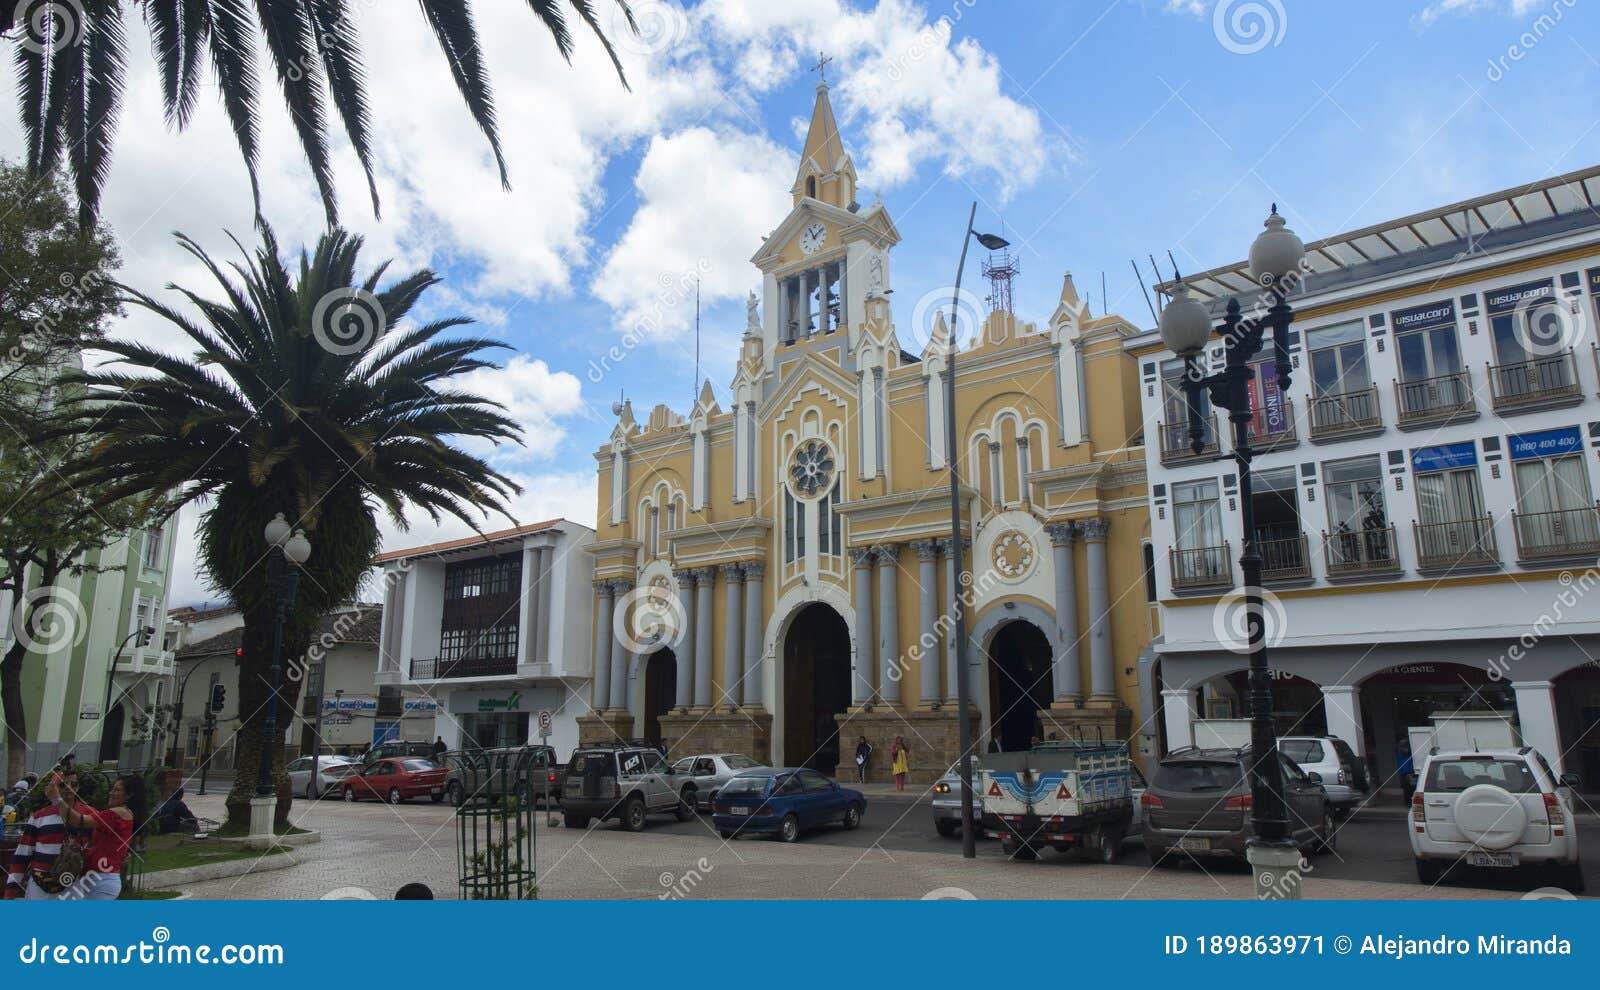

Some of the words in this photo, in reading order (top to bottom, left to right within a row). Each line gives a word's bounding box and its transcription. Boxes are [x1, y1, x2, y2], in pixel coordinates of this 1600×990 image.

[1264, 377, 1280, 426] OMNILIFE
[1539, 440, 1556, 448] 400
[1558, 437, 1575, 447] 400
